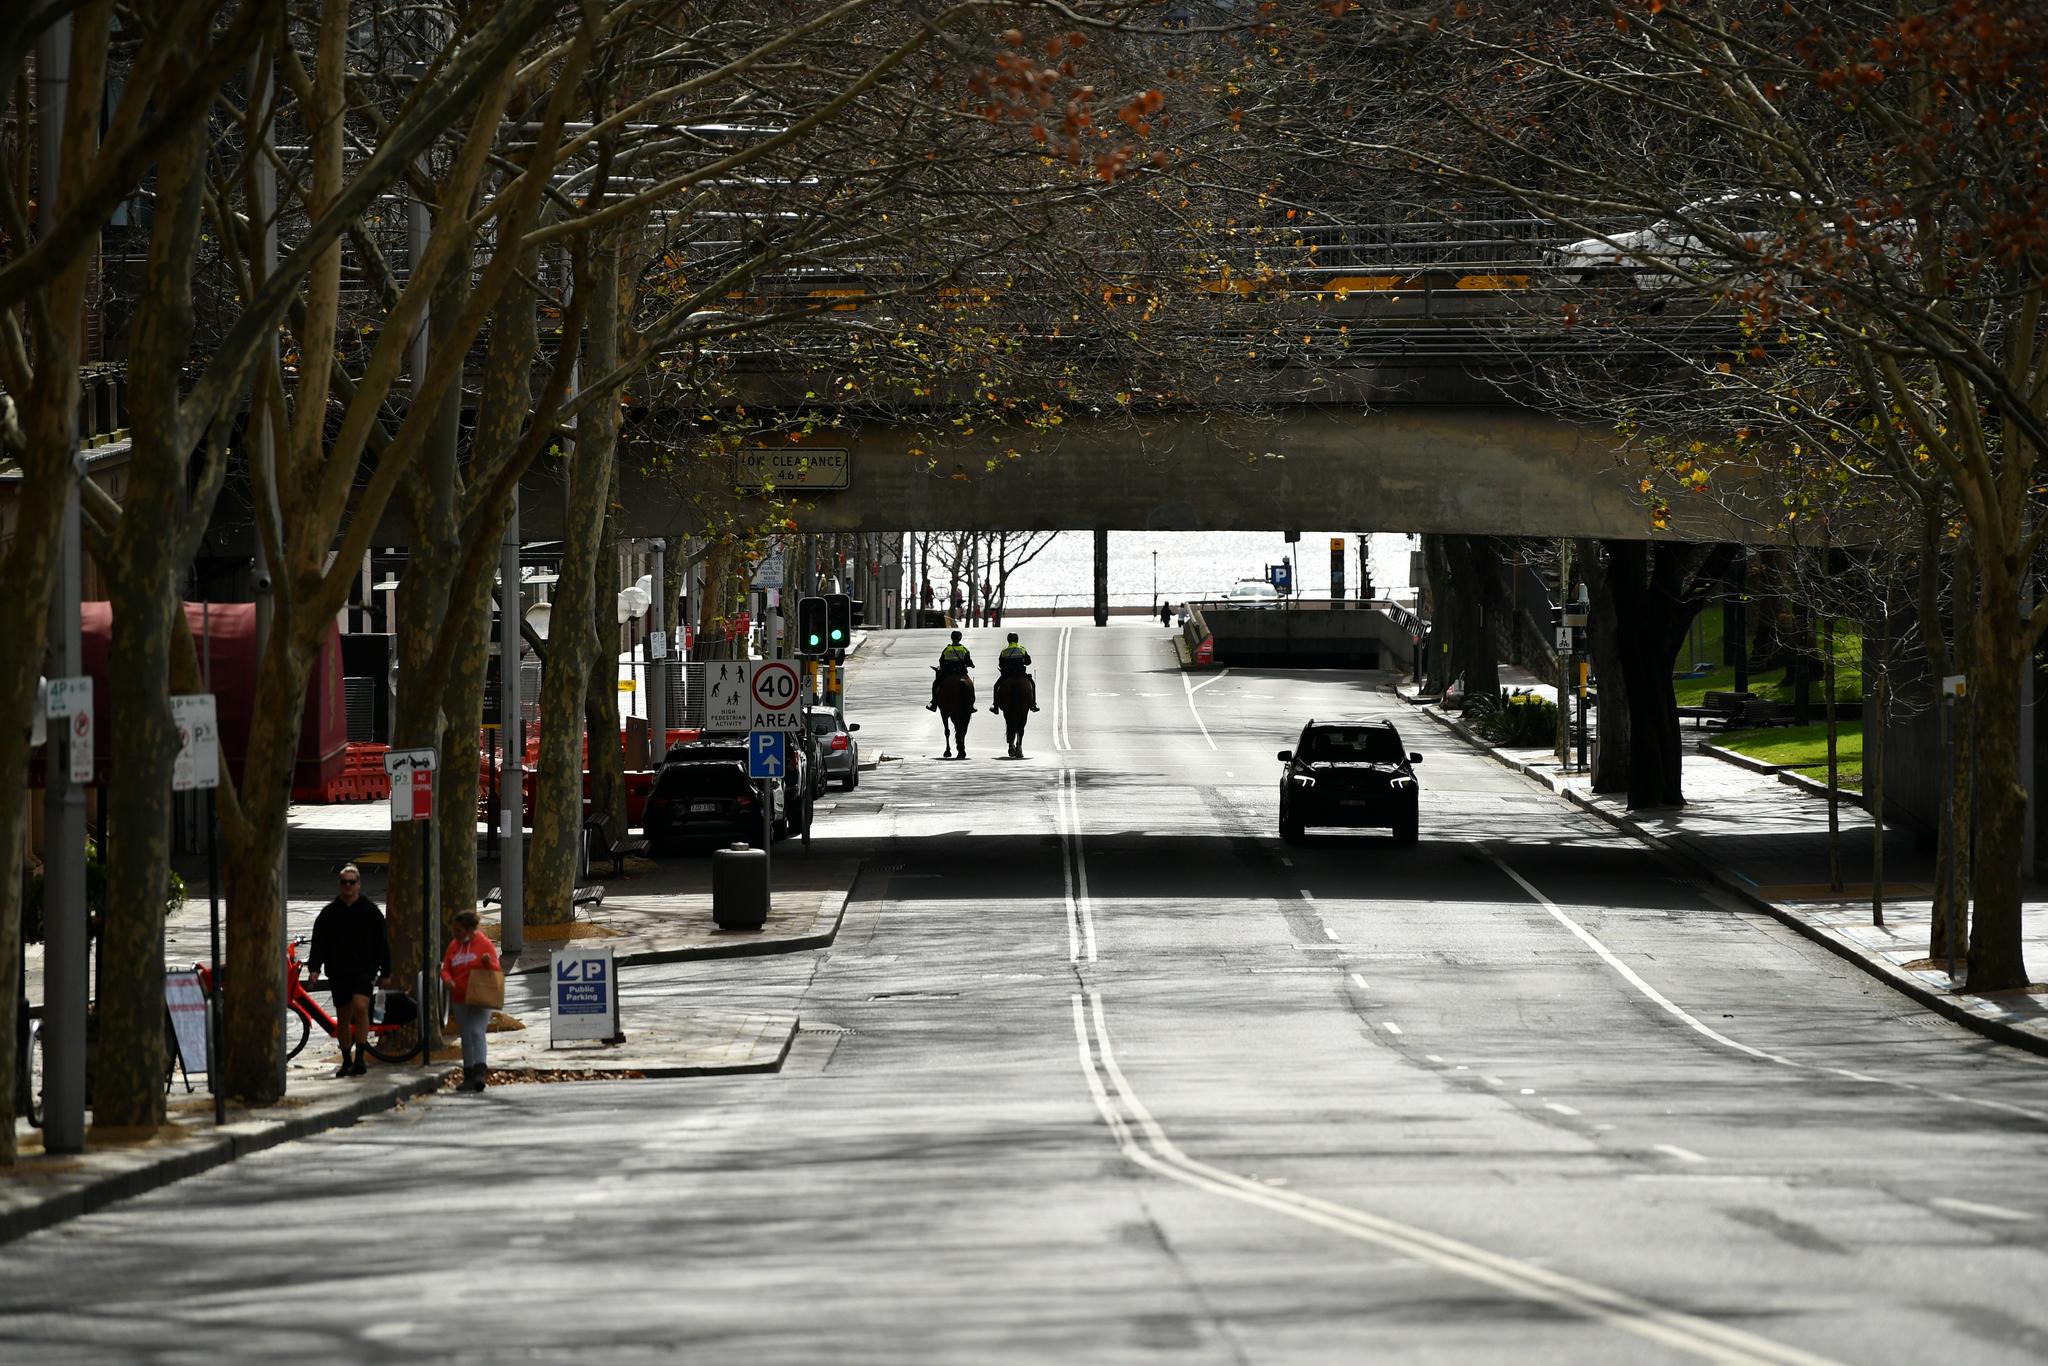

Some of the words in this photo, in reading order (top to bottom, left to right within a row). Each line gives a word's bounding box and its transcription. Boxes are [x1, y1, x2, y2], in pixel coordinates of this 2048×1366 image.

[777, 470, 794, 480] 4.6
[1275, 568, 1287, 583] P
[758, 675, 793, 698] 40
[754, 713, 799, 728] AREA
[759, 735, 775, 754] P
[394, 774, 402, 786] P
[586, 962, 601, 979] P
[566, 993, 598, 1001] Parking
